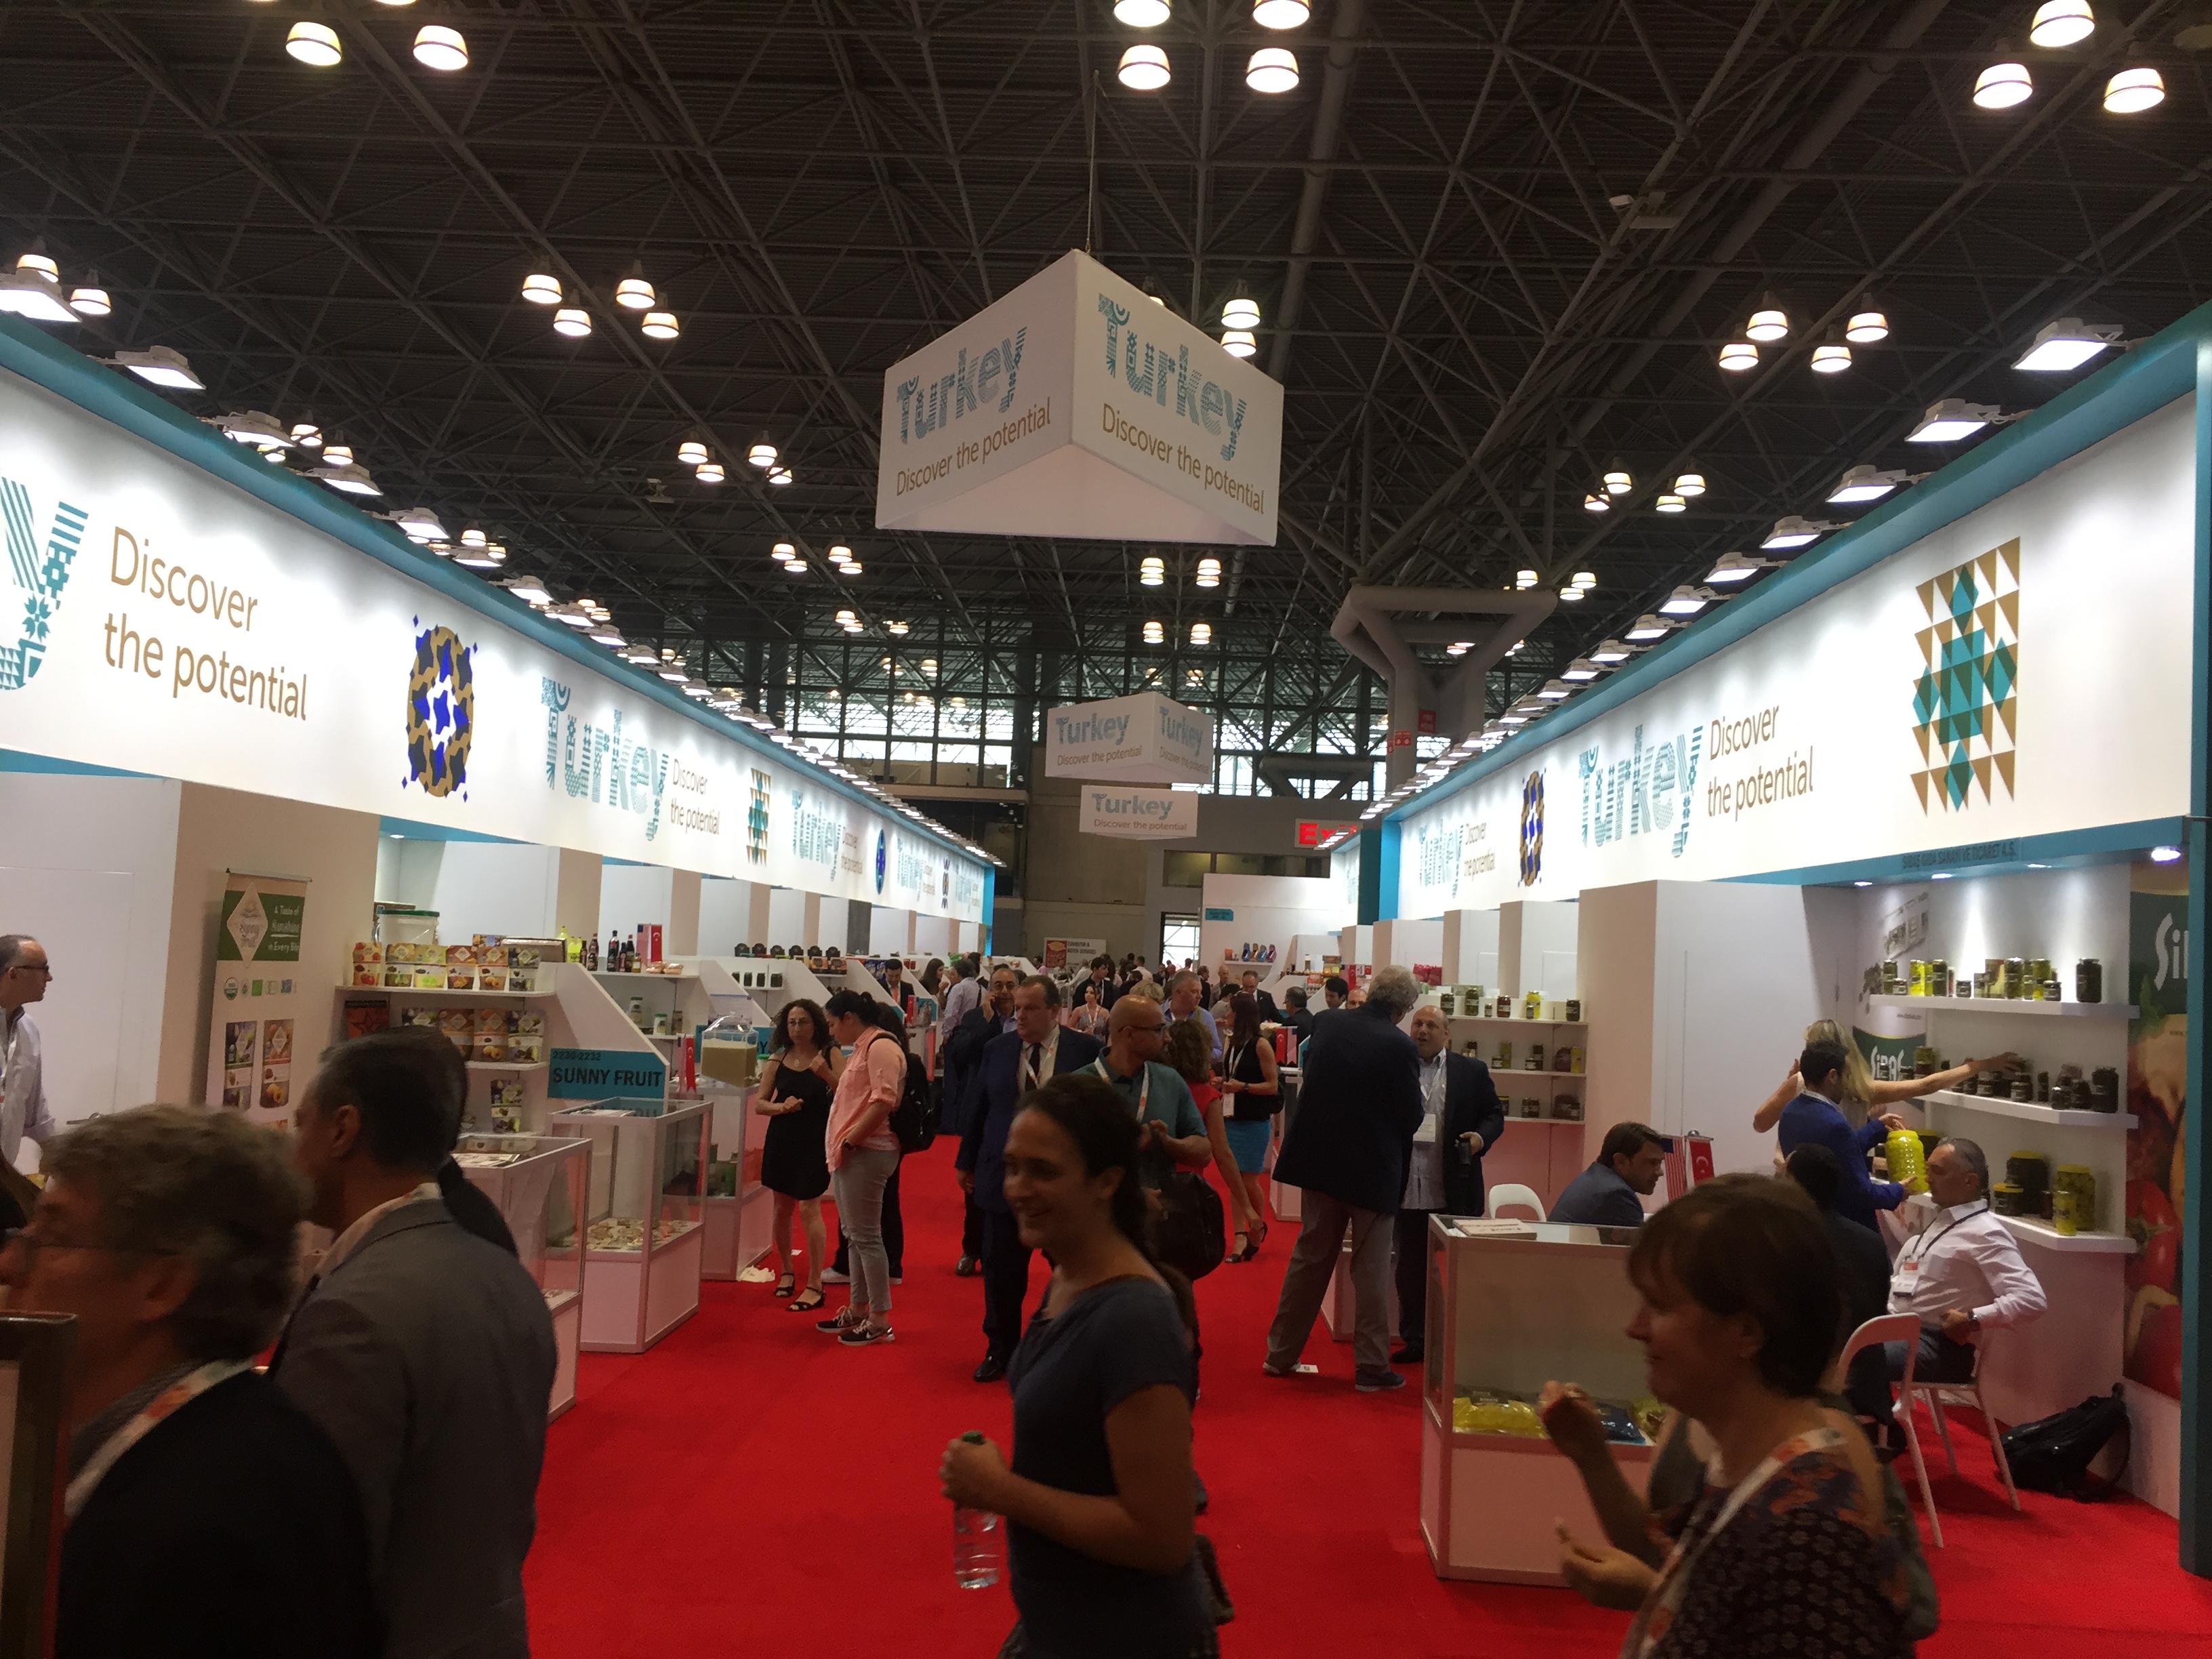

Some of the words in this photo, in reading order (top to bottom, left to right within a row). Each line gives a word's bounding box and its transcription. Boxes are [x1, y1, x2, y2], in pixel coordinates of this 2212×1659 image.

[897, 326, 1028, 446] Turkey
[1099, 293, 1248, 462] Turkey
[896, 454, 953, 497] Discover
[956, 439, 979, 470] the
[982, 396, 1051, 464] potential
[1103, 403, 1173, 465] Discover
[1177, 446, 1202, 480] the
[1204, 465, 1265, 516] potential
[110, 526, 258, 632] Discover
[104, 613, 163, 678] the
[173, 644, 307, 721] potential
[541, 676, 670, 842] Turkey
[1055, 712, 1131, 746] Turkey
[1057, 753, 1090, 766] Discover
[1091, 751, 1105, 762] the
[1106, 745, 1143, 763] potential
[1159, 705, 1204, 757] Turkey
[1708, 705, 1780, 761] Discover
[672, 758, 708, 795] Discover
[1091, 793, 1174, 821] Turkey
[1579, 724, 1704, 859] Turkey
[1707, 776, 1732, 817] the
[1734, 745, 1814, 822] potential
[670, 797, 684, 826] the
[684, 806, 720, 834] potential
[1094, 819, 1130, 829] Discover
[1133, 821, 1147, 830] the
[1149, 822, 1187, 832] potential
[552, 1067, 611, 1084] SUNNY
[614, 1069, 663, 1087] FRUIT
